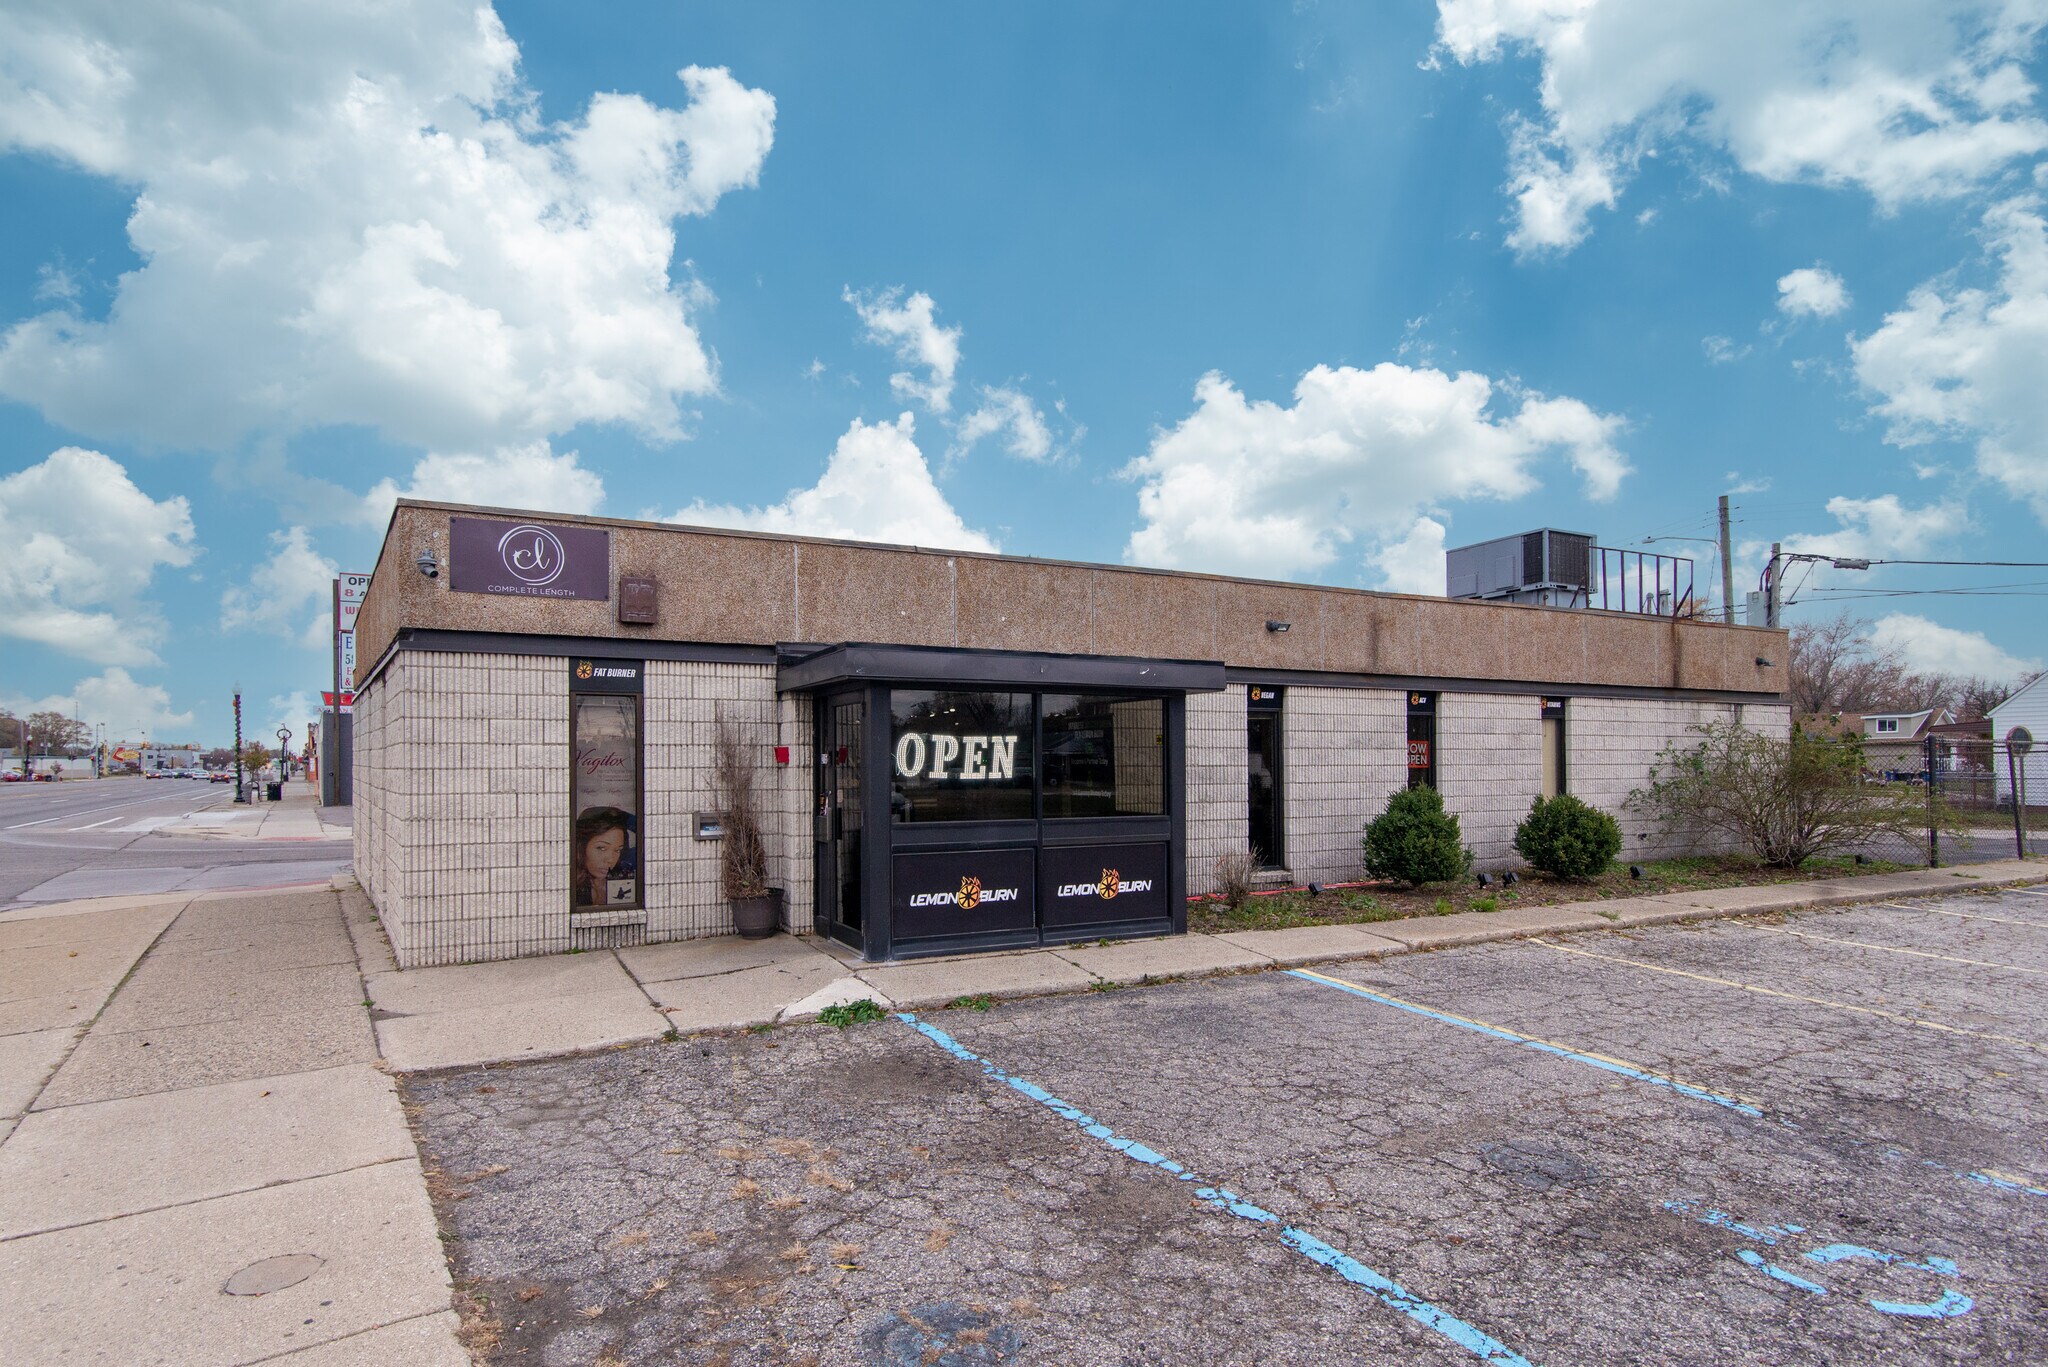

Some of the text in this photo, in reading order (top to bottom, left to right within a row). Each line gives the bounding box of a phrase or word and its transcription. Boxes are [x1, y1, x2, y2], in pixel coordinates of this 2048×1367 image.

[488, 585, 575, 596] COMPLETE LENGTH
[593, 668, 636, 678] FAT BURNER
[1407, 743, 1427, 754] OW
[896, 732, 1018, 780] OPEN
[1057, 879, 1152, 897] LEMON BURN
[910, 888, 1018, 907] LEMON BURN
